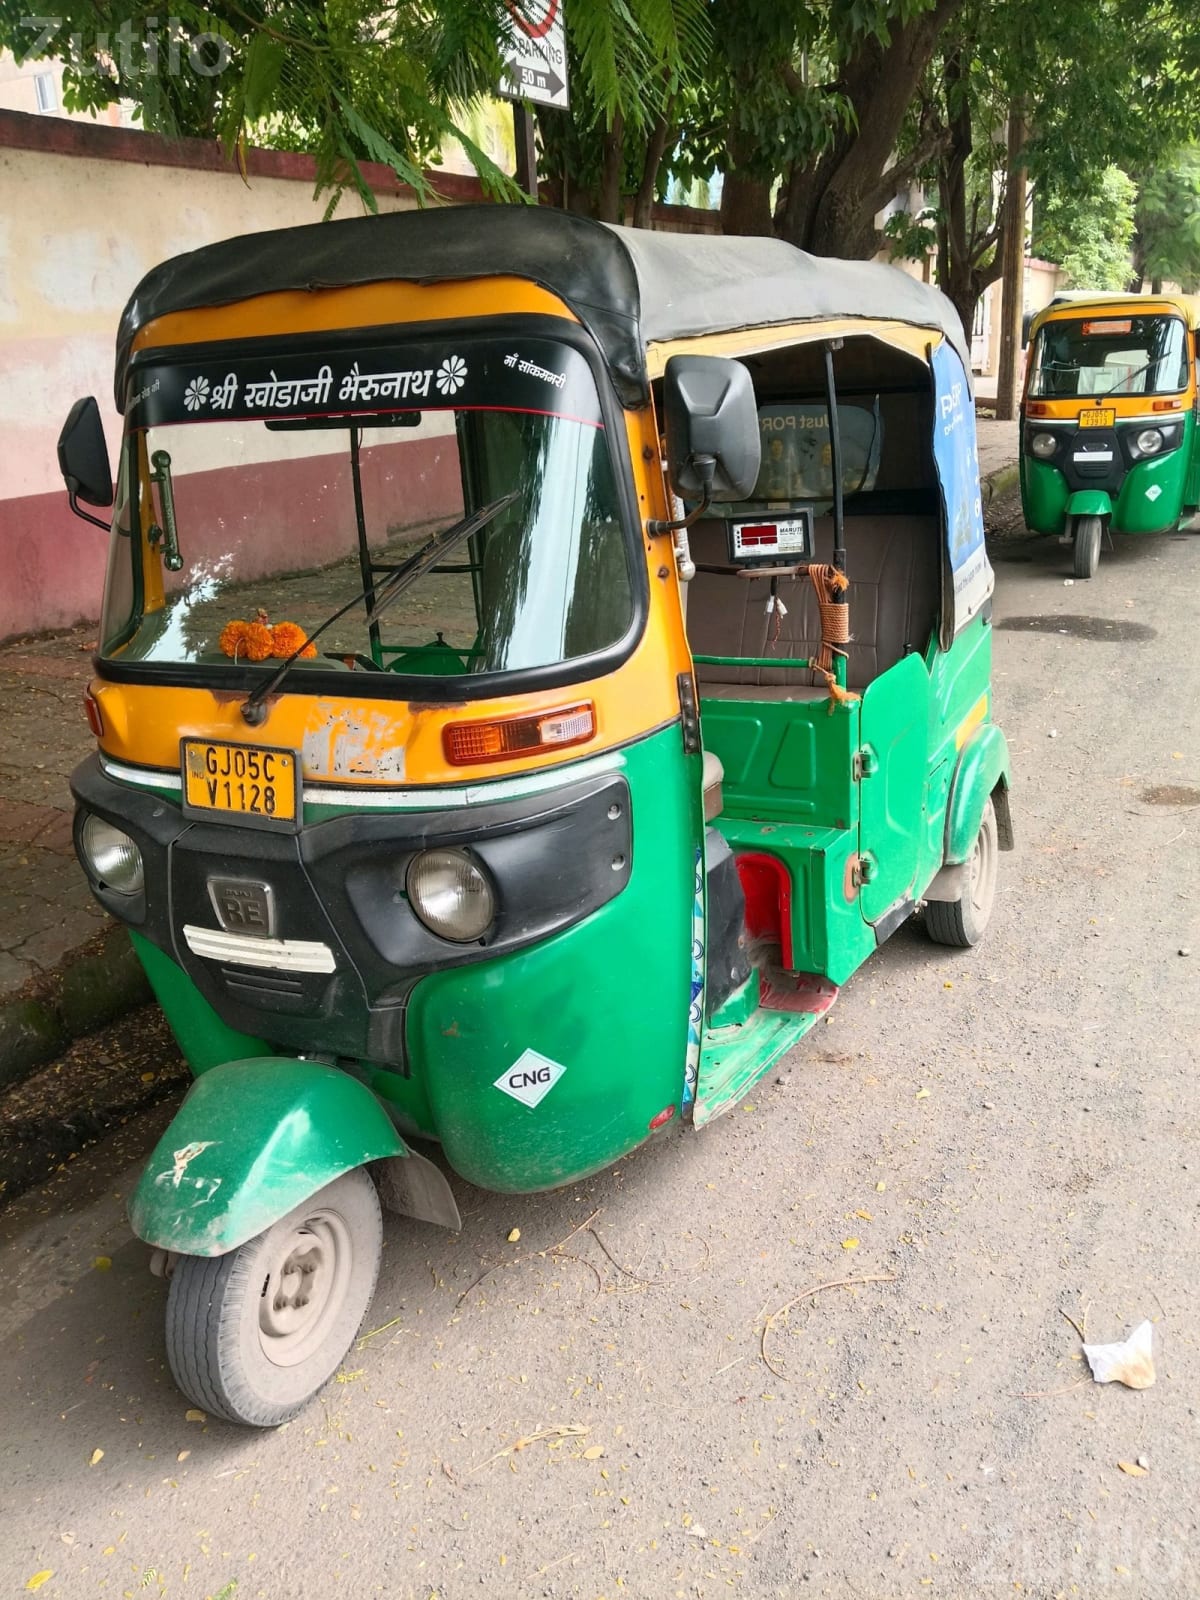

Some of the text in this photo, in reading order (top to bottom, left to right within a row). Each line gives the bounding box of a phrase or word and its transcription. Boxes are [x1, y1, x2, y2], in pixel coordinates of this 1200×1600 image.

[520, 37, 563, 65] PARKING
[521, 68, 546, 88] 50 m
[210, 361, 434, 410] श्री खोडाजी भैरुनाथ
[192, 770, 205, 780] IND
[206, 746, 275, 783] GJ05C
[206, 778, 276, 815] V1128
[222, 898, 265, 927] RE
[508, 1066, 551, 1089] CNG
